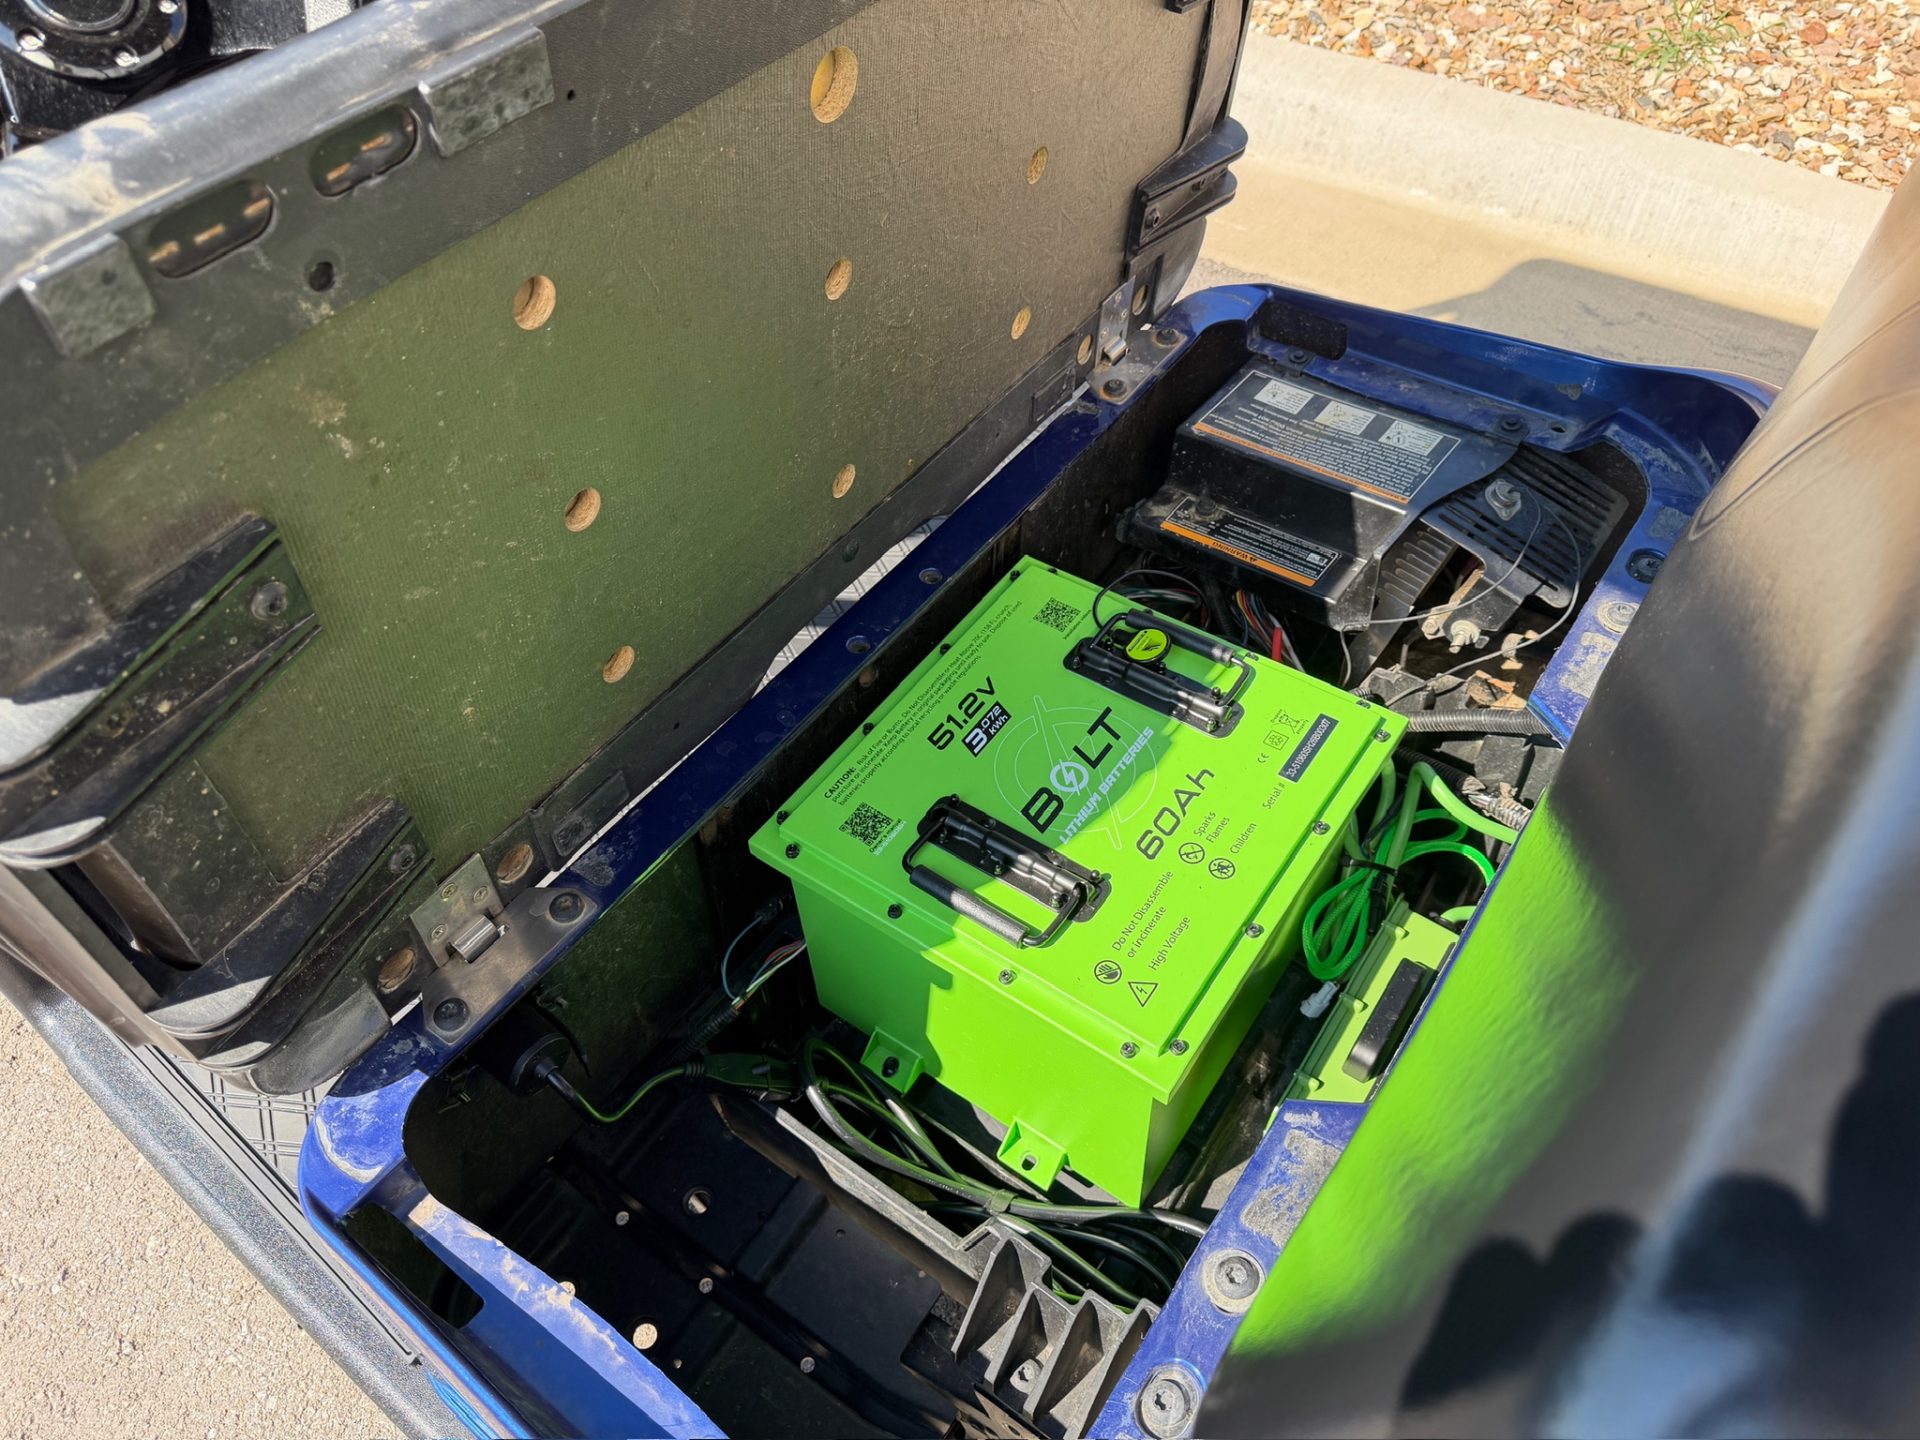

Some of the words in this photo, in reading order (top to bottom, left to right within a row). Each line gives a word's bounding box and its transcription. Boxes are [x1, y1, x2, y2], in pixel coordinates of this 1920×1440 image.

[1210, 541, 1250, 560] WARNING
[824, 767, 857, 799] CAUTION:
[856, 754, 869, 766] Risk
[867, 747, 875, 756] of
[871, 739, 883, 750] Fire
[901, 709, 911, 719] Do
[908, 700, 920, 710] Not
[917, 672, 946, 702] Disassemble
[948, 656, 961, 668] Heat
[958, 642, 975, 658] Above
[831, 778, 856, 803] puncture
[882, 734, 898, 748] Keep
[894, 717, 914, 735] Battery
[917, 693, 935, 712] original
[933, 670, 958, 695] packaging
[954, 659, 967, 671] until
[964, 647, 979, 661] ready
[987, 613, 1010, 634] Dispose
[988, 715, 1008, 735] kWh
[837, 783, 862, 806] batteries
[860, 762, 882, 785] properly
[880, 737, 906, 763] according
[906, 719, 921, 733] local
[918, 699, 941, 721] recycling
[942, 679, 958, 695] waste
[1021, 707, 1120, 833] BOLT
[1060, 793, 1101, 844] LITHIUM
[1099, 727, 1153, 794] BATTERIES
[1136, 769, 1214, 860] 60Ah
[1193, 811, 1216, 837] Sparks
[1262, 787, 1282, 810] Serial
[1205, 817, 1230, 843] Flames
[1229, 823, 1257, 854] Children
[1111, 936, 1127, 951] Do
[1121, 920, 1139, 937] Not
[1133, 871, 1174, 921] Disassemble
[1127, 947, 1137, 958] or
[1132, 906, 1167, 948] incinerate
[1148, 949, 1169, 971] High
[1162, 917, 1191, 948] Voltage
